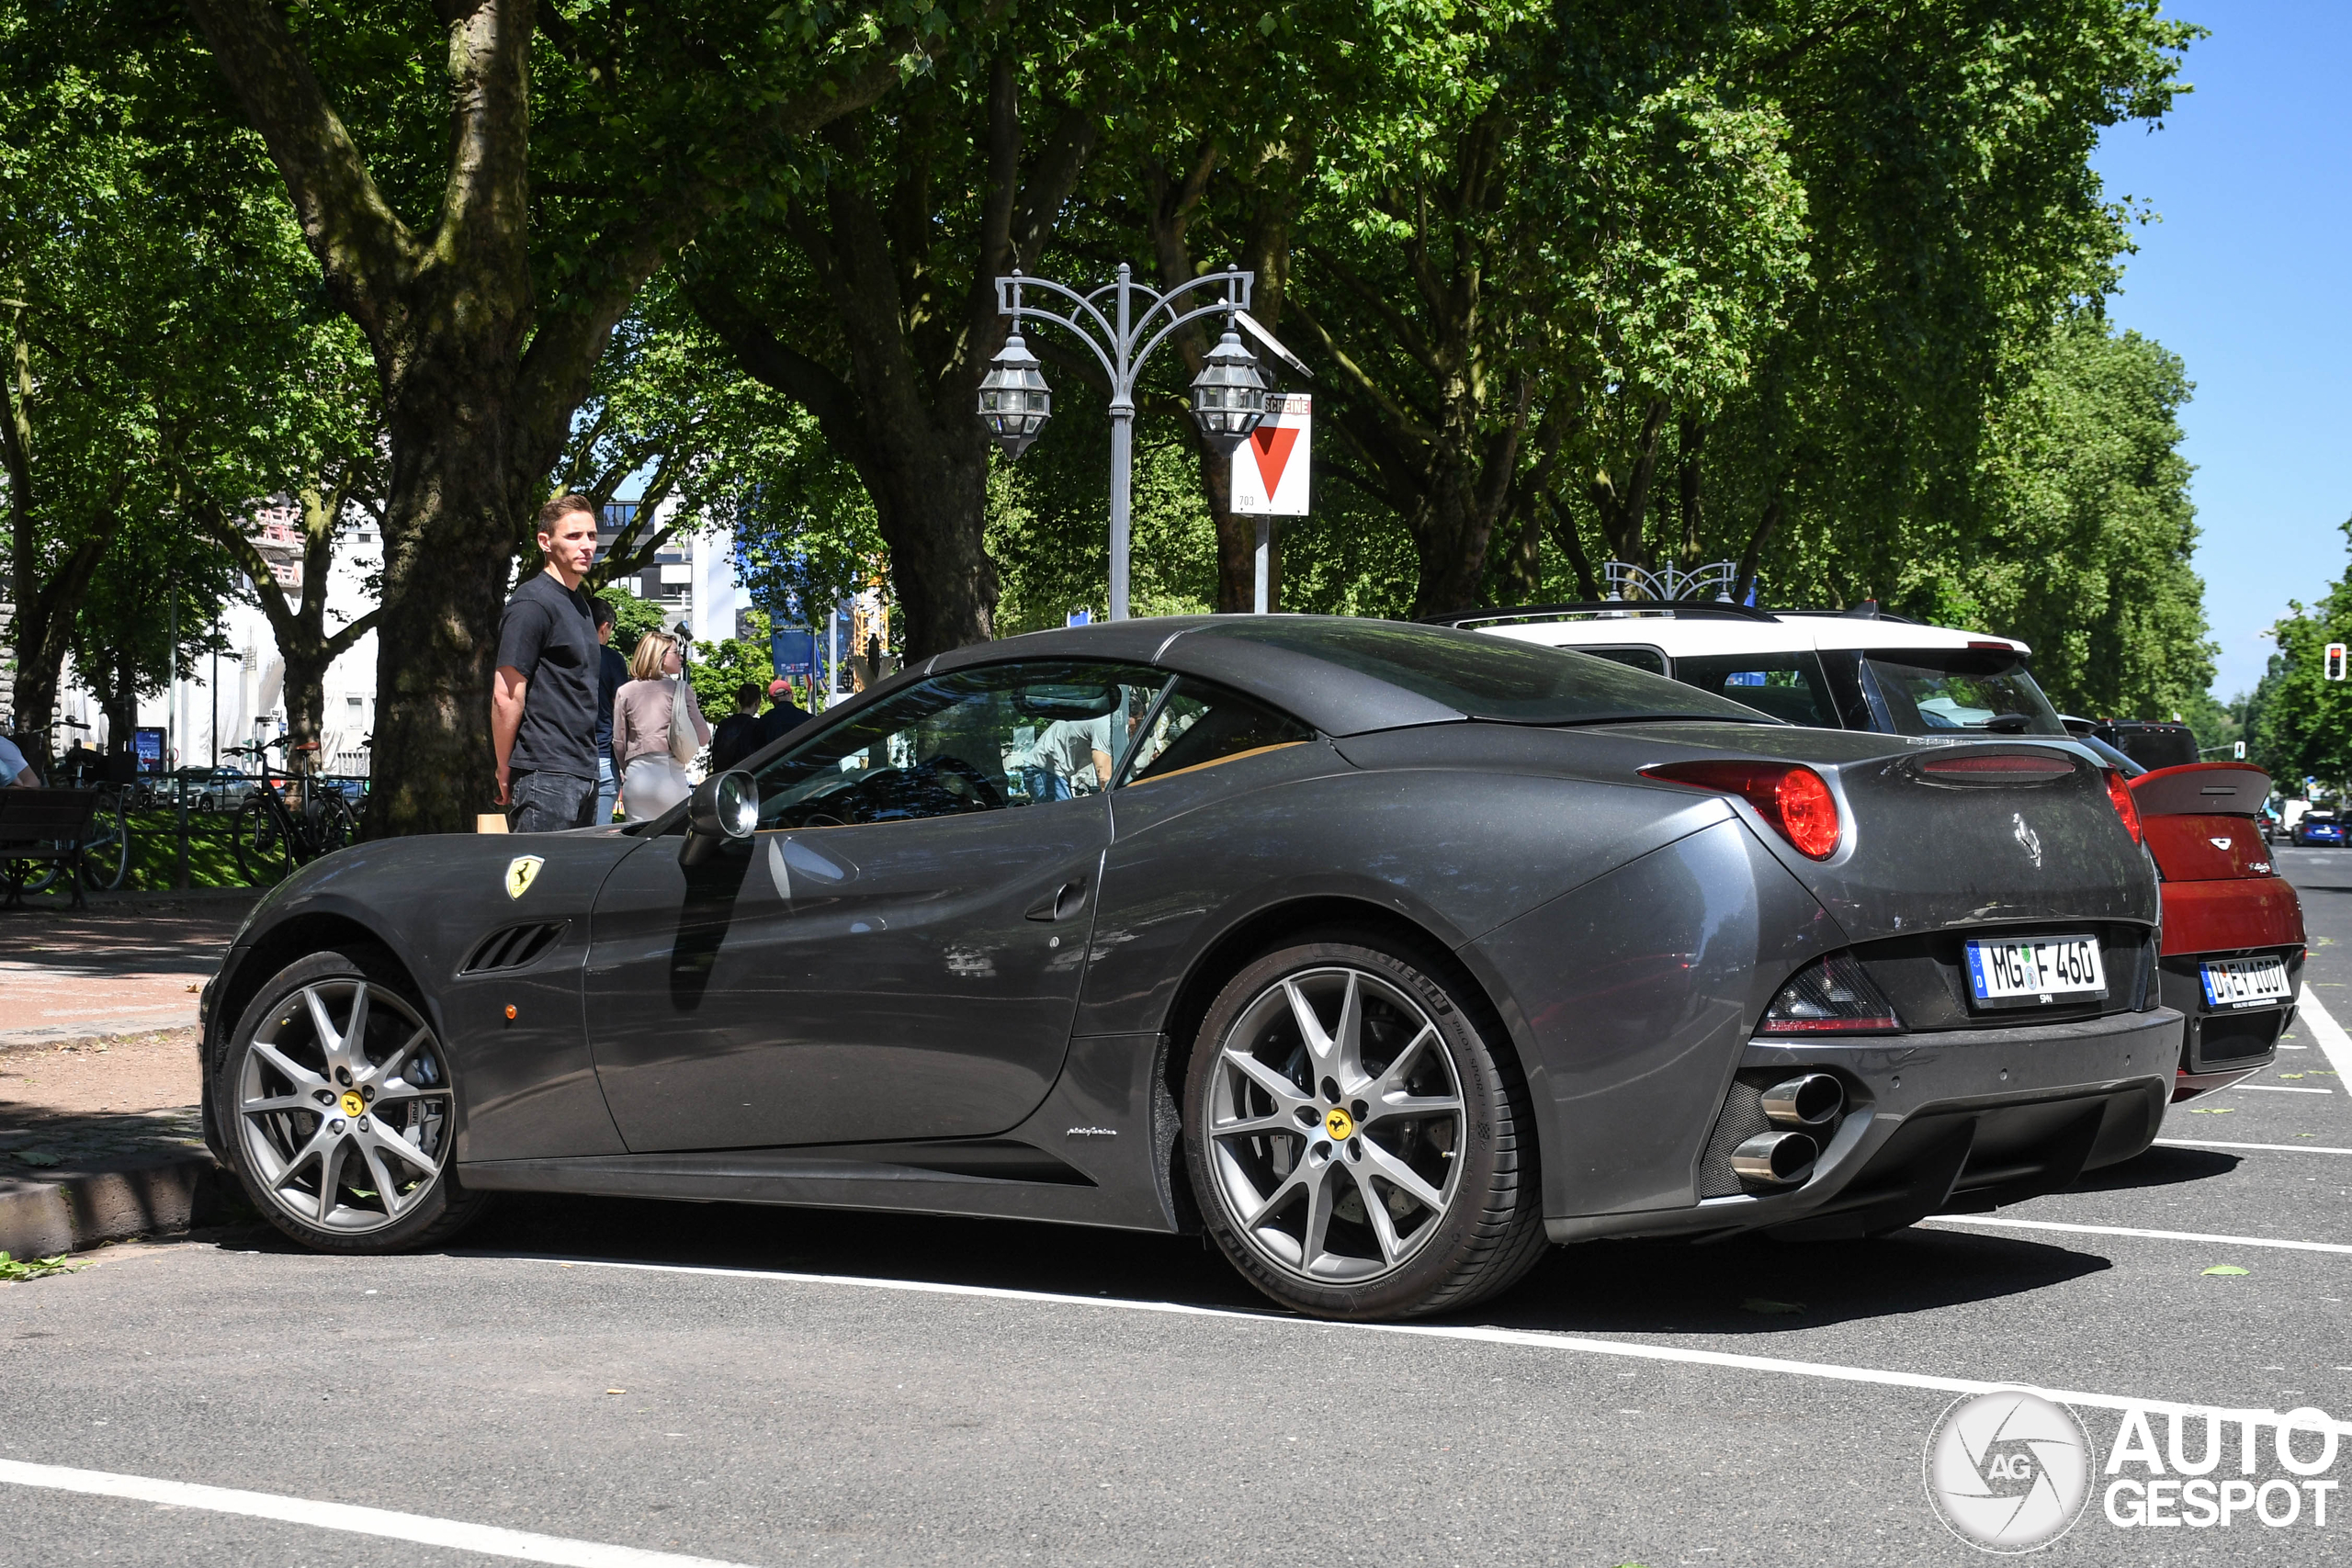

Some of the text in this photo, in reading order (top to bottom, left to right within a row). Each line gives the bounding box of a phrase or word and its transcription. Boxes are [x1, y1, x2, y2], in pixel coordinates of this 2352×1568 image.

[1265, 400, 1308, 413] SCHEINE
[1239, 496, 1254, 506] 703
[1990, 941, 2095, 989] MG F 460
[1975, 975, 1984, 988] D
[2209, 965, 2224, 998] D
[2250, 960, 2284, 994] 1007
[1453, 1021, 1472, 1052] PILOT
[1470, 1057, 1484, 1098] SPORT
